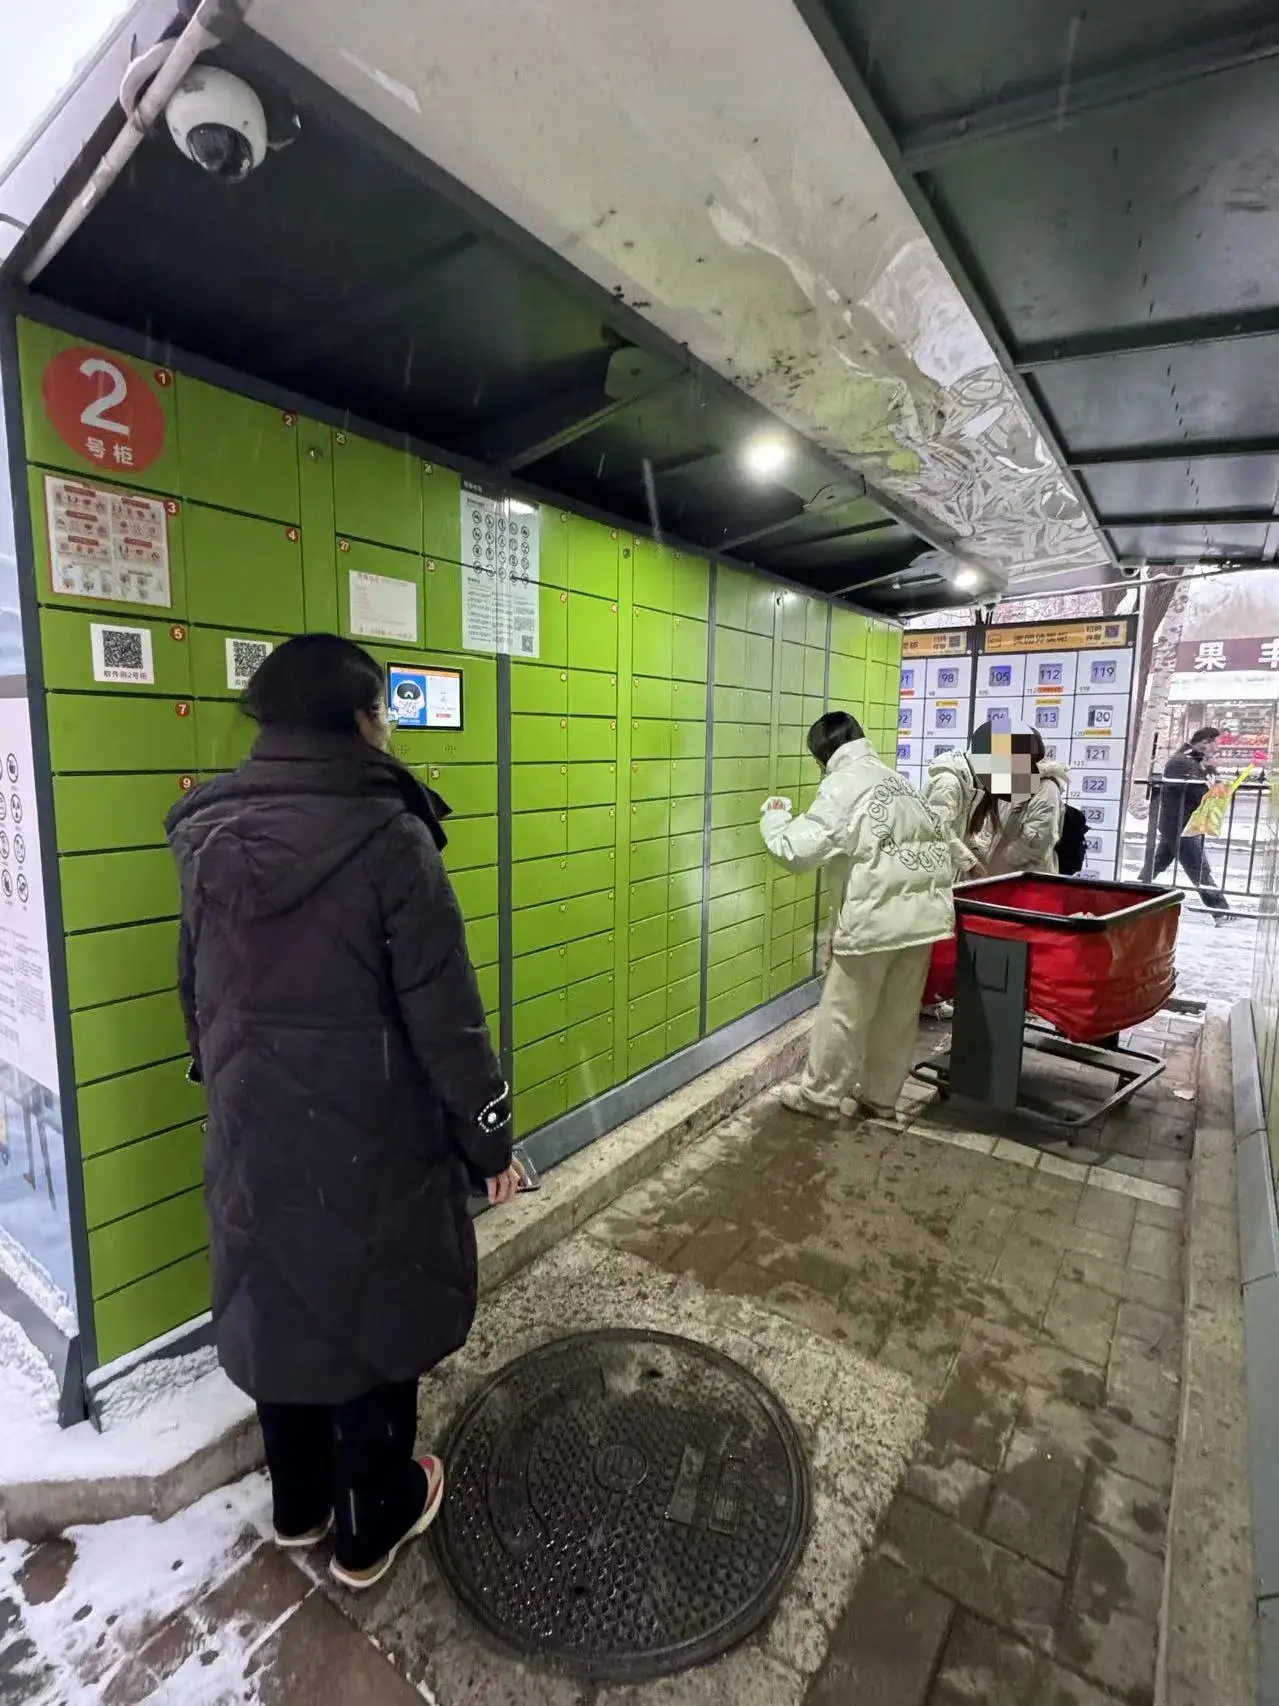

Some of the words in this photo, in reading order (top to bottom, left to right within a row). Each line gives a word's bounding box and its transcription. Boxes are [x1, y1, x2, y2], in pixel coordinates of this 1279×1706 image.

[79, 358, 131, 436] 2
[85, 437, 135, 466] 号柜
[990, 671, 1009, 681] 105
[1040, 670, 1060, 680] 112
[1092, 667, 1115, 678] 119
[941, 673, 954, 683] 98
[939, 714, 952, 723] 99
[1037, 713, 1057, 723] 113
[1086, 749, 1106, 760] 121
[1084, 780, 1105, 791] 122
